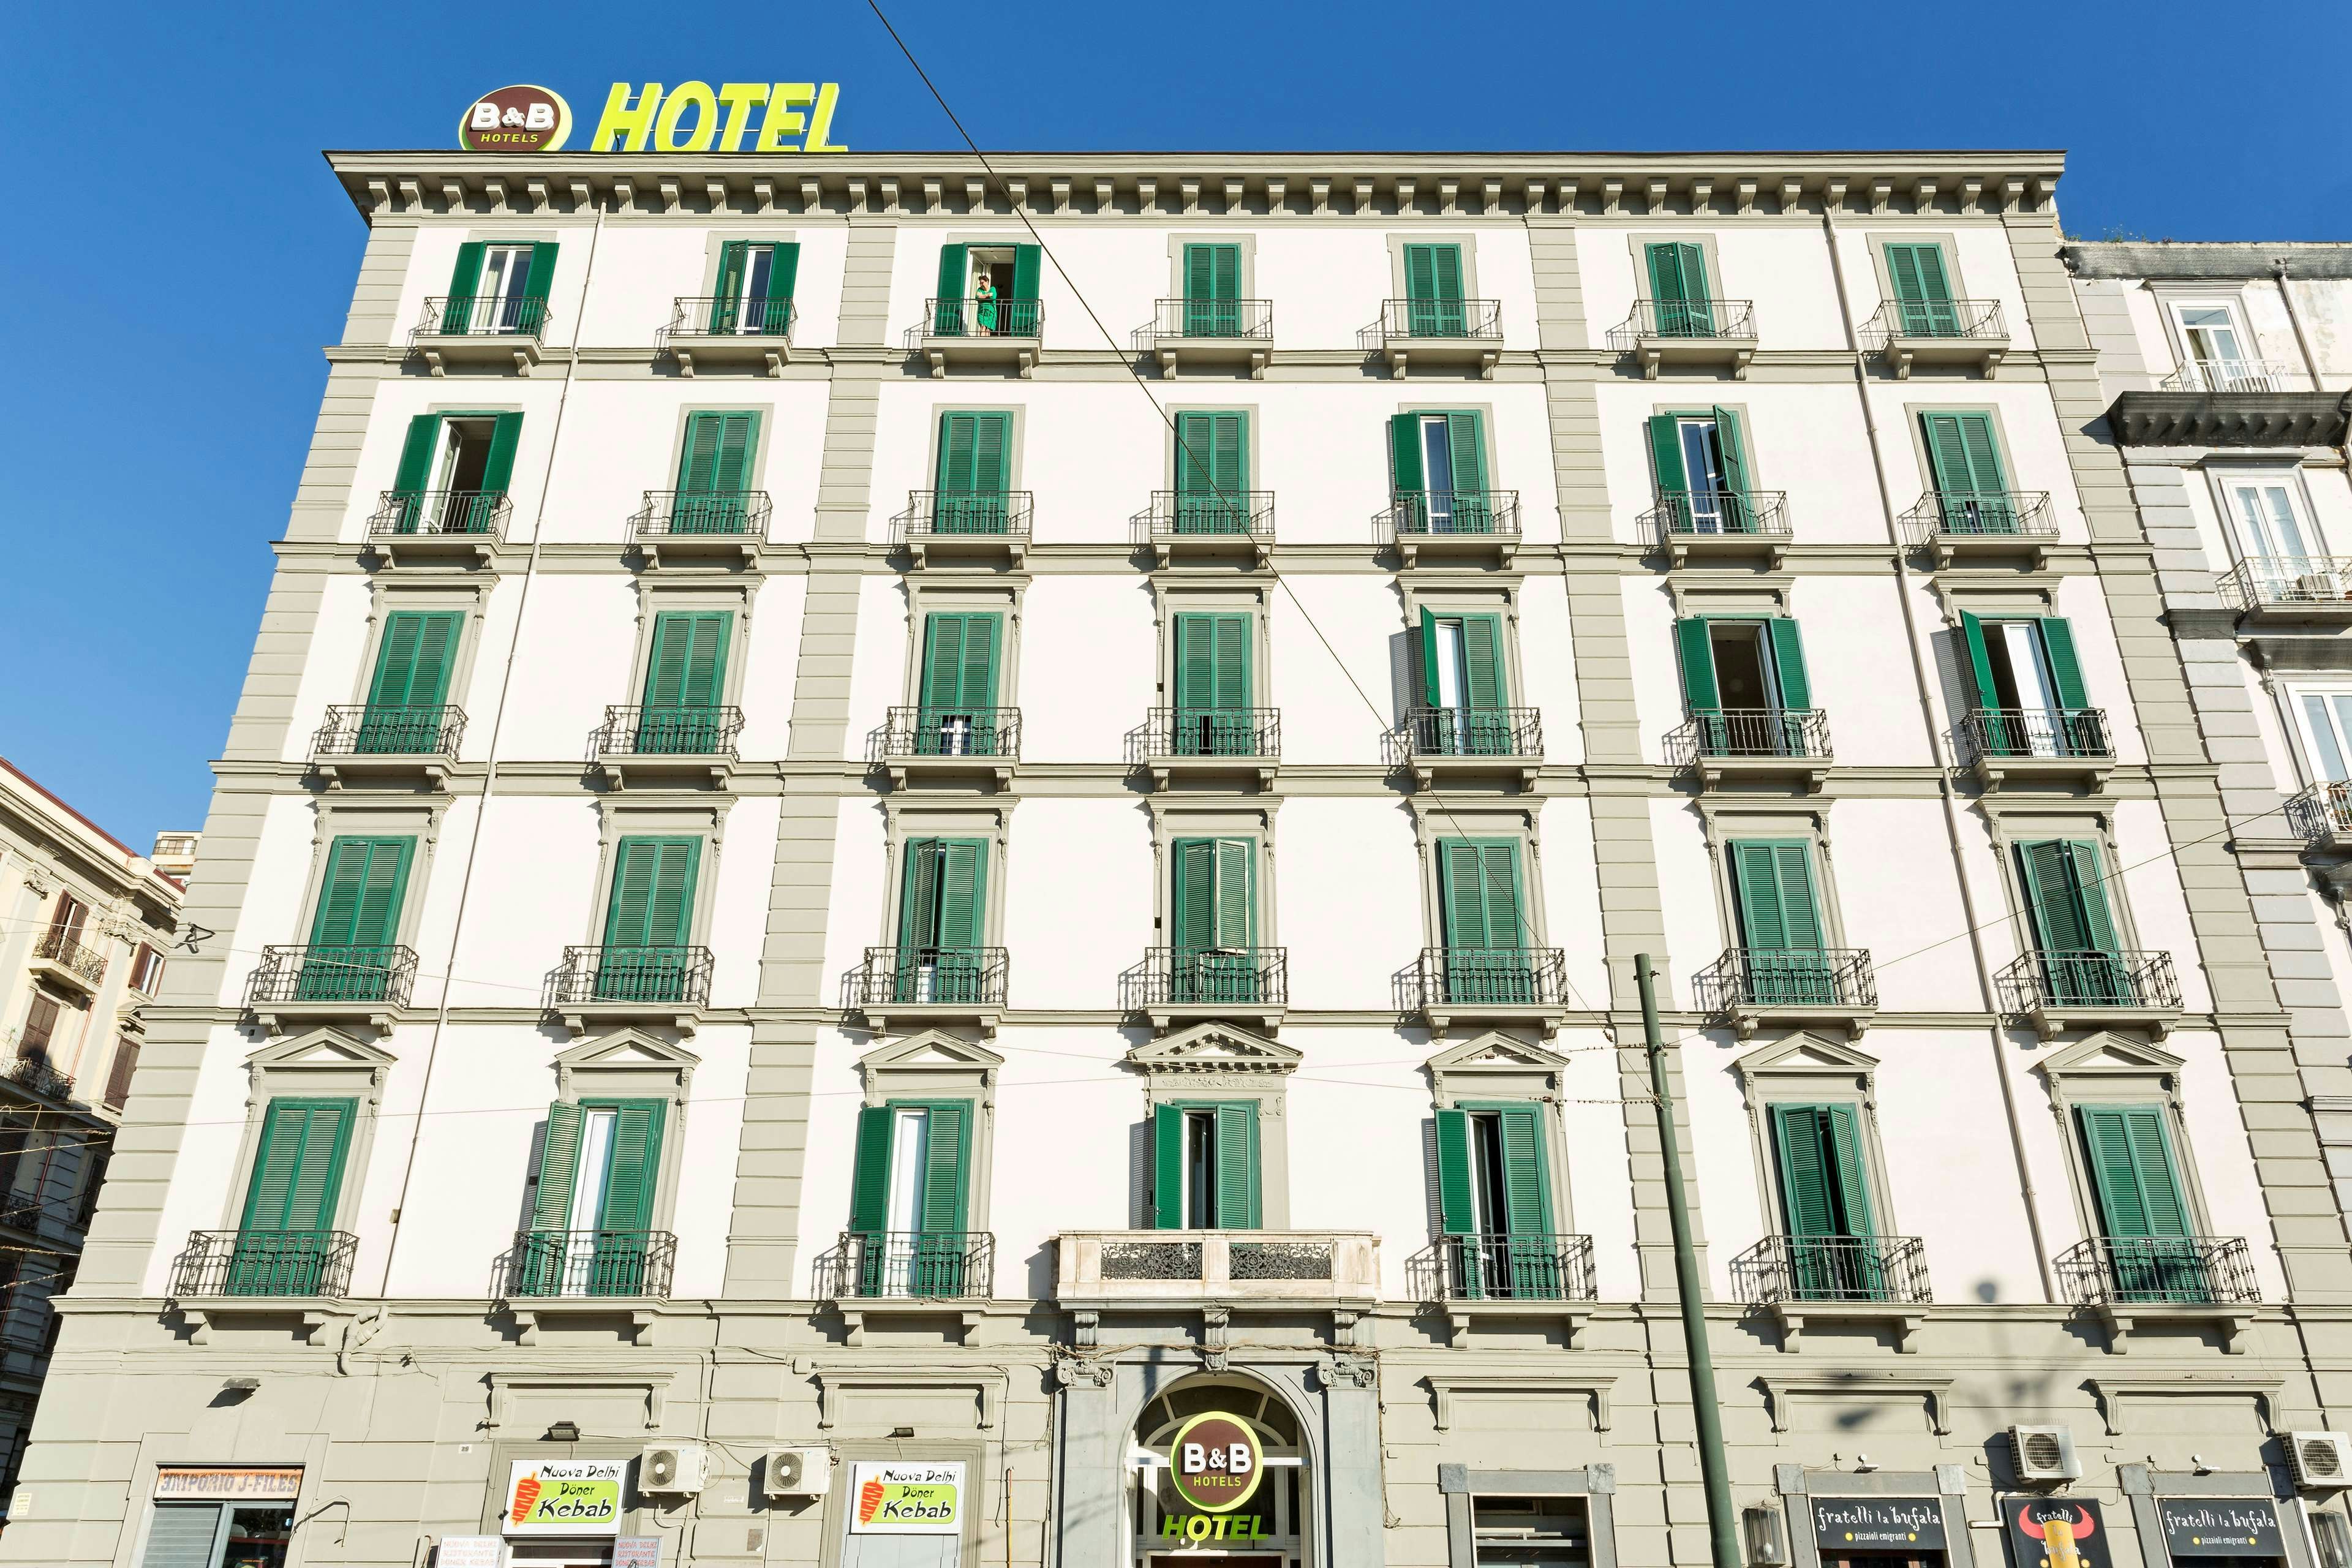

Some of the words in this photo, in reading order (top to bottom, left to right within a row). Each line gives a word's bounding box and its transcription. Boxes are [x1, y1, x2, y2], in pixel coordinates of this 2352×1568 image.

[470, 102, 554, 131] B&B
[590, 80, 848, 152] HOTEL
[481, 134, 538, 143] HOTELS
[1185, 1442, 1252, 1473] B&B
[540, 1465, 582, 1478] Nuova
[586, 1465, 620, 1480] Delhi
[883, 1470, 922, 1482] Nuova
[925, 1470, 957, 1484] Delhi
[1194, 1476, 1242, 1487] HOTELS
[238, 1474, 298, 1492] J-FILES
[560, 1482, 595, 1496] Döner
[902, 1486, 934, 1499] Döner
[538, 1498, 611, 1518] Kebab
[883, 1500, 951, 1518] Kebab
[1817, 1506, 1872, 1531] fratelli
[1875, 1510, 1889, 1524] la
[1889, 1506, 1940, 1531] bufala
[2037, 1509, 2073, 1528] fratelli
[2166, 1509, 2215, 1535] fratelli
[2218, 1513, 2230, 1528] la
[2229, 1509, 2277, 1535] bufala
[1162, 1514, 1269, 1542] HOTEL
[1855, 1532, 1879, 1542] pizzaioli
[1880, 1532, 1907, 1542] emigranti
[2201, 1536, 2223, 1546] pizzaioli
[2223, 1536, 2247, 1546] emigranti
